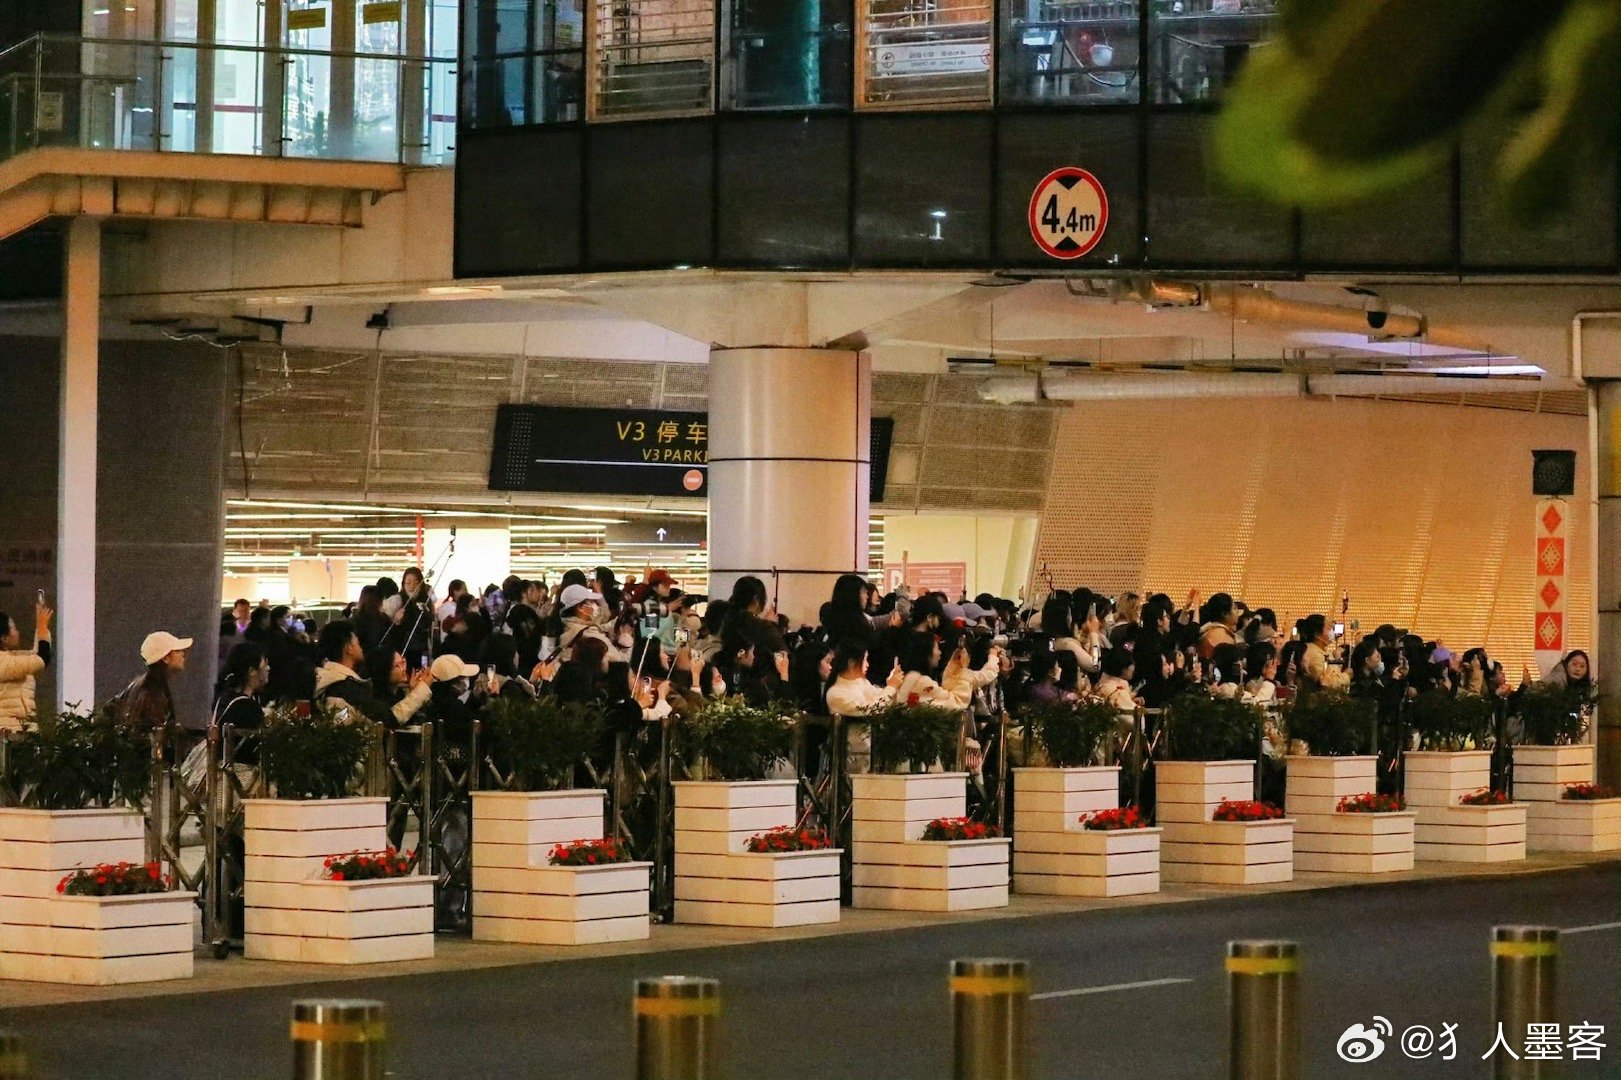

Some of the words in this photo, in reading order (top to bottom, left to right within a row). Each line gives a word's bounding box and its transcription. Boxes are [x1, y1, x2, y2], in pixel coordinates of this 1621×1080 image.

[1041, 193, 1096, 234] 4.4m
[616, 420, 646, 441] V3
[656, 420, 708, 445] 停车
[642, 448, 660, 461] V3
